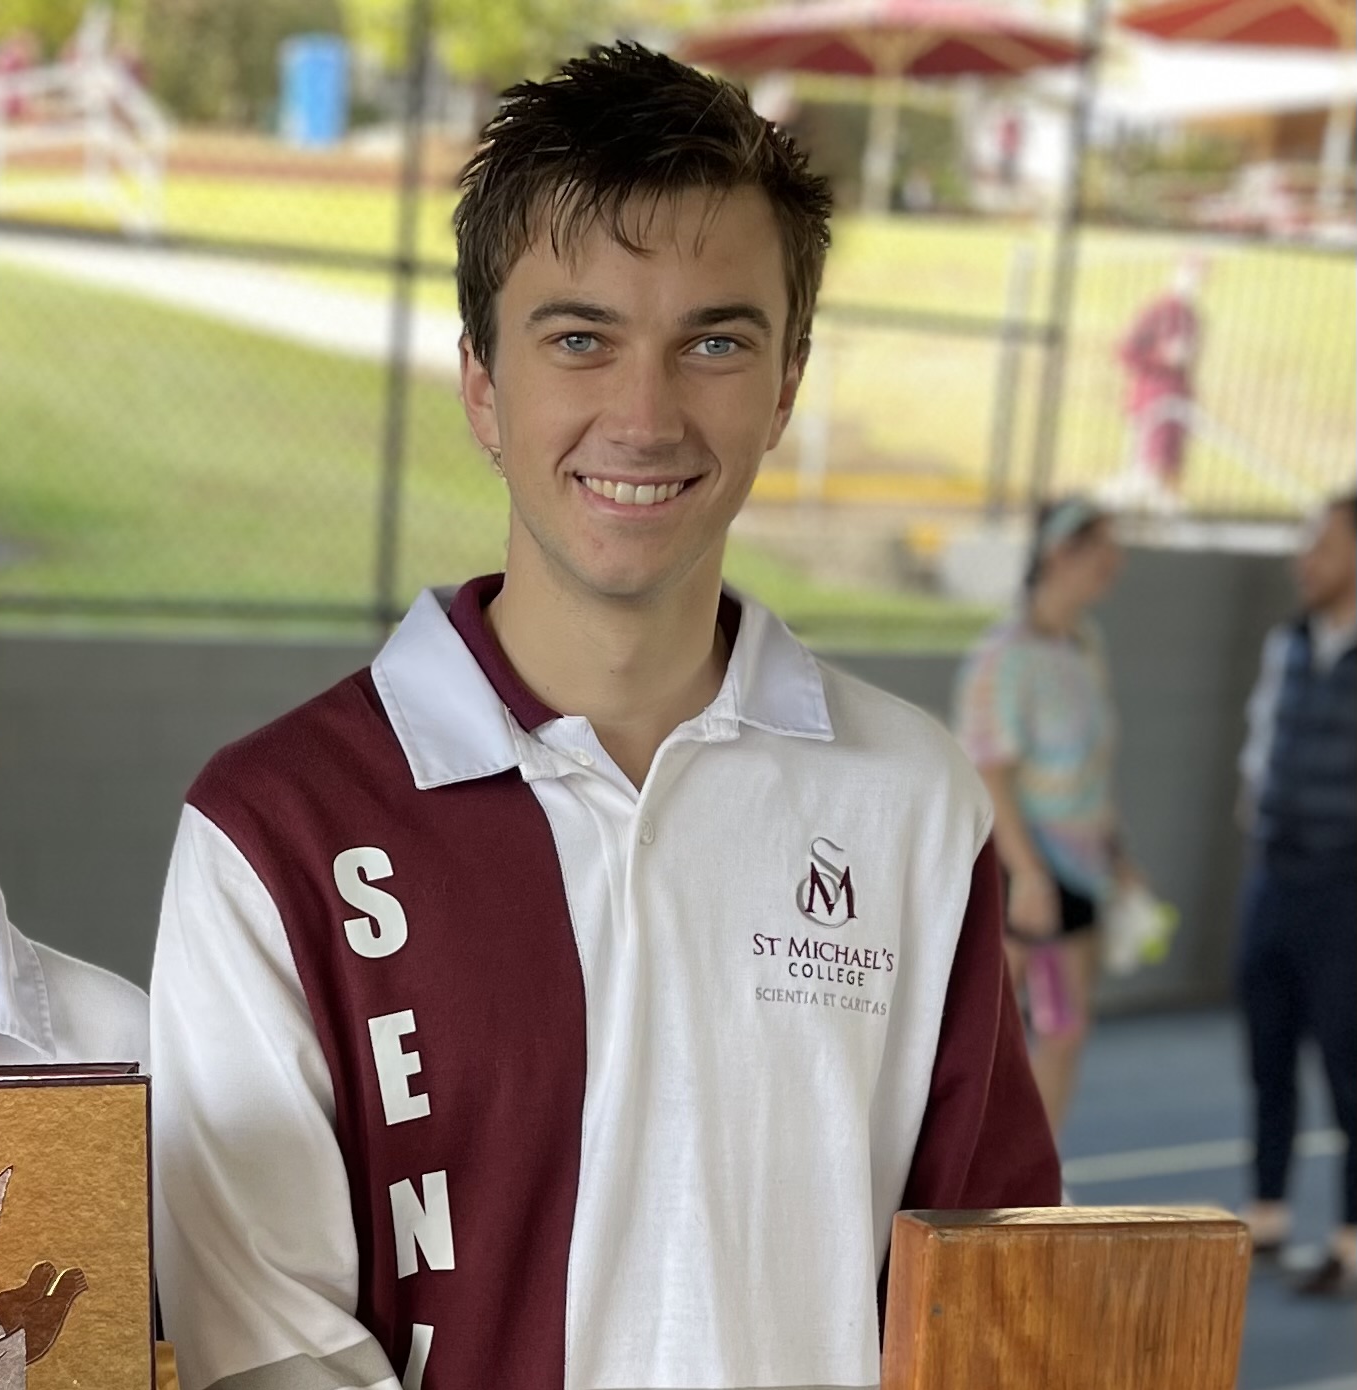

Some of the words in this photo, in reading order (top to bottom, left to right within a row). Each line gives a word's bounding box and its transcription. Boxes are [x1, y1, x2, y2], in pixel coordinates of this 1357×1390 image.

[753, 933, 782, 956] ST
[788, 936, 894, 972] MICHAEL'S
[788, 962, 865, 987] COLLEGE
[755, 986, 819, 1005] SCIENTIA
[823, 993, 836, 1007] ET
[840, 995, 888, 1016] CARITAS
